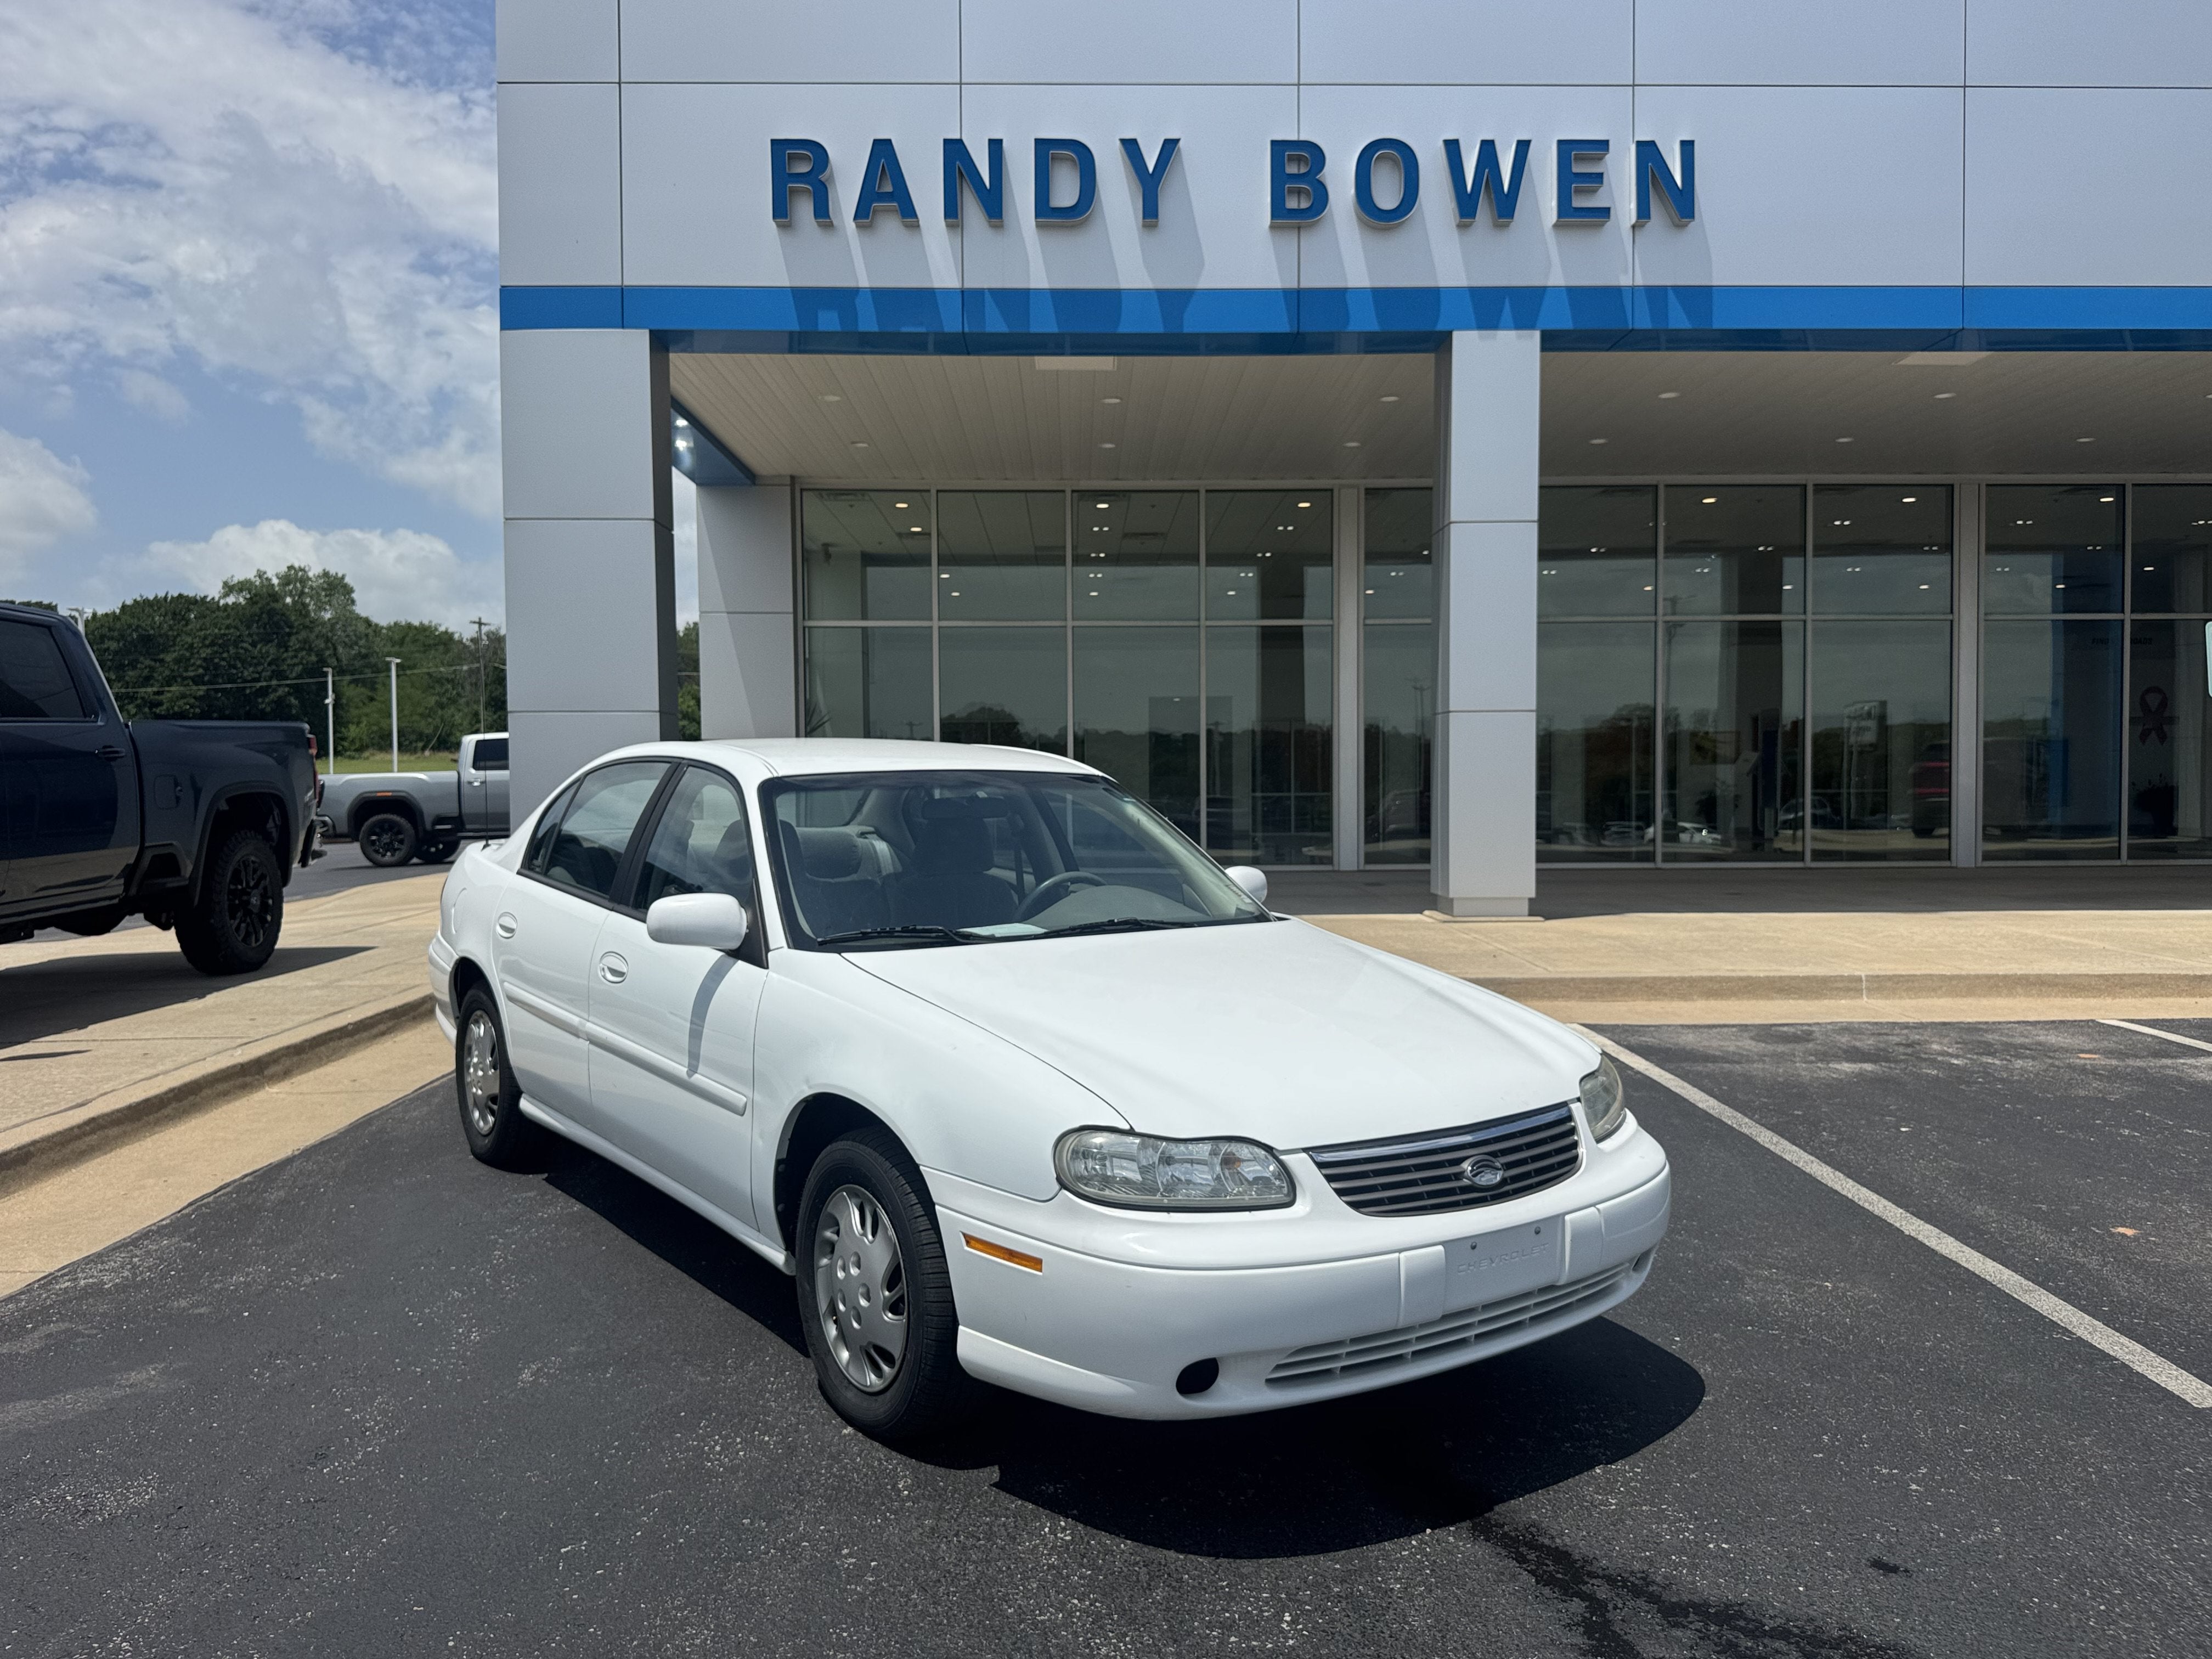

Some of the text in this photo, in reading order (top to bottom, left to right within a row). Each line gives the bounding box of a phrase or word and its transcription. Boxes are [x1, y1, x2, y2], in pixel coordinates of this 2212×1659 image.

[770, 138, 1696, 227] RANDY BOWEN
[1457, 1243, 1549, 1274] CHEVROLET
